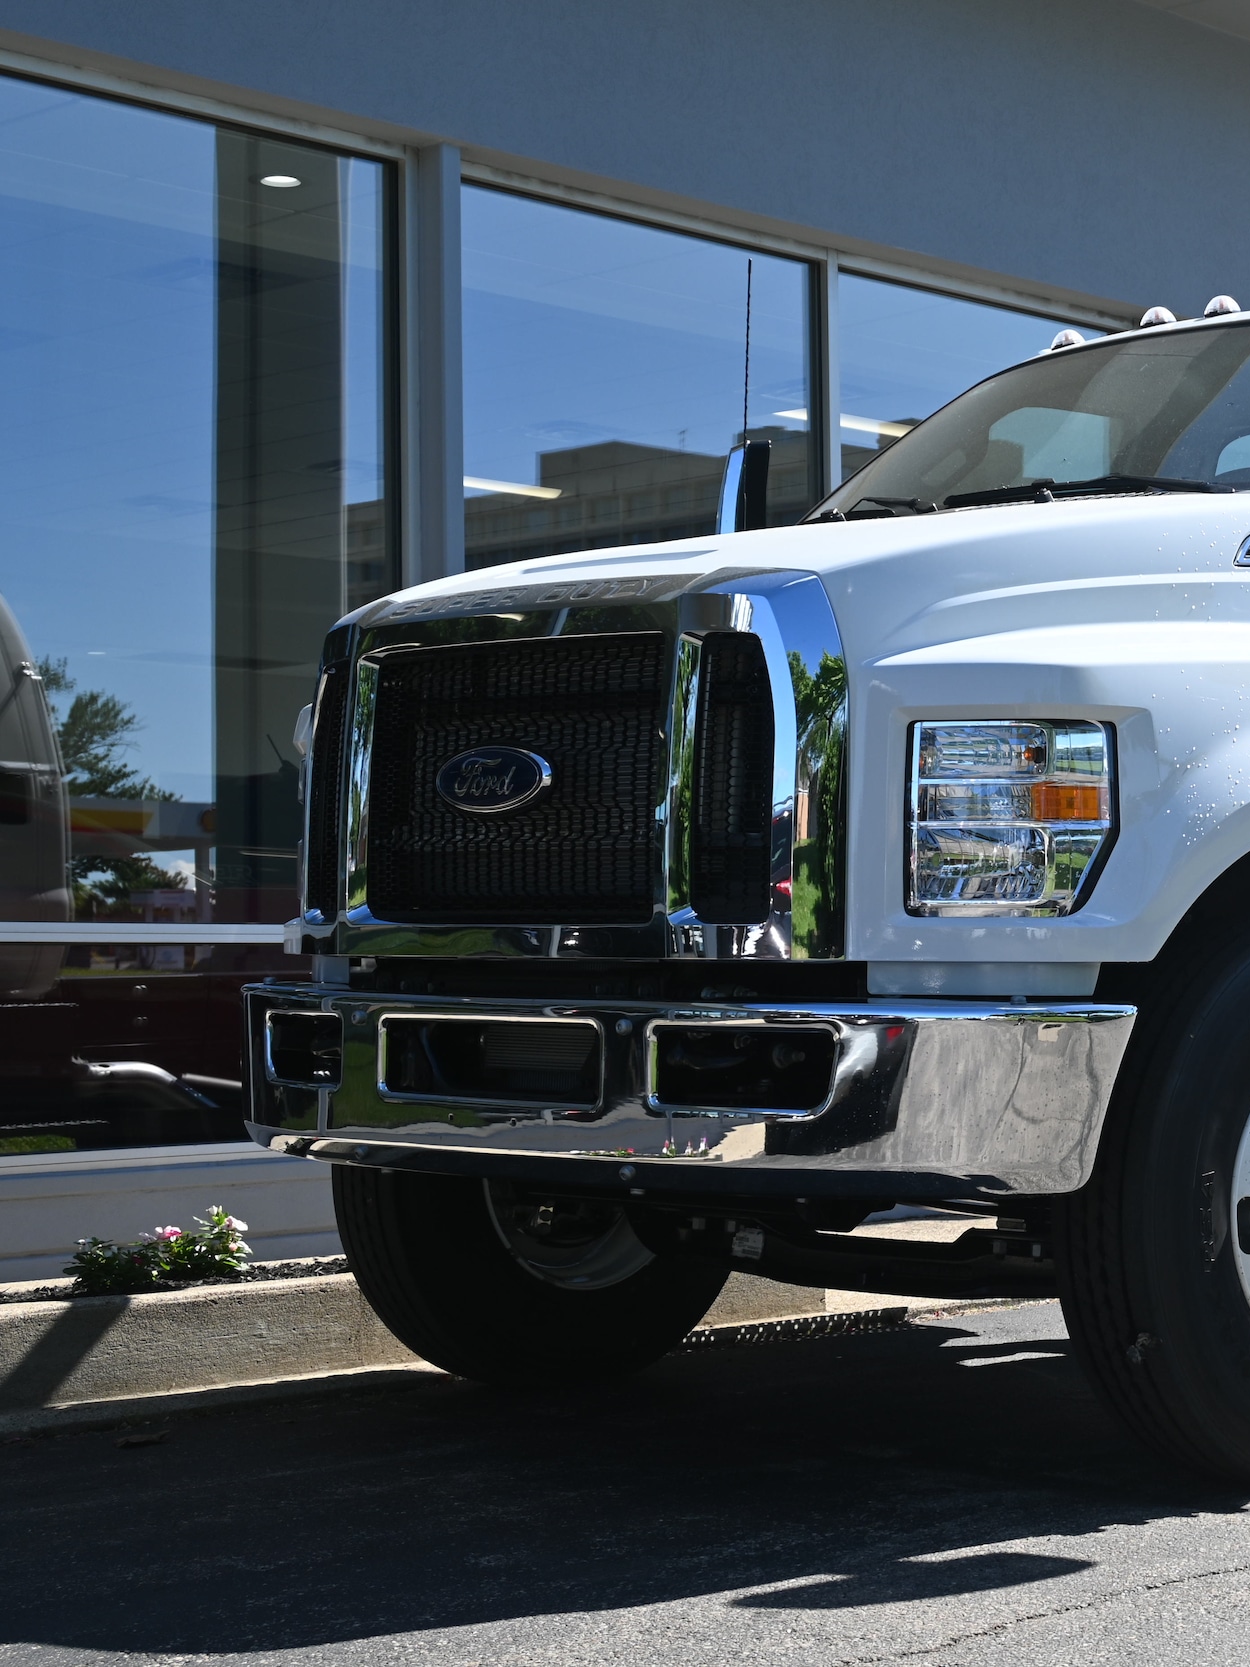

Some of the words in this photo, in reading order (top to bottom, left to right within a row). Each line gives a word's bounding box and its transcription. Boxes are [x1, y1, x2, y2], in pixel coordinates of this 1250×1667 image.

[389, 587, 529, 619] SUPER
[535, 578, 670, 603] DUTY
[455, 757, 516, 797] Ford
